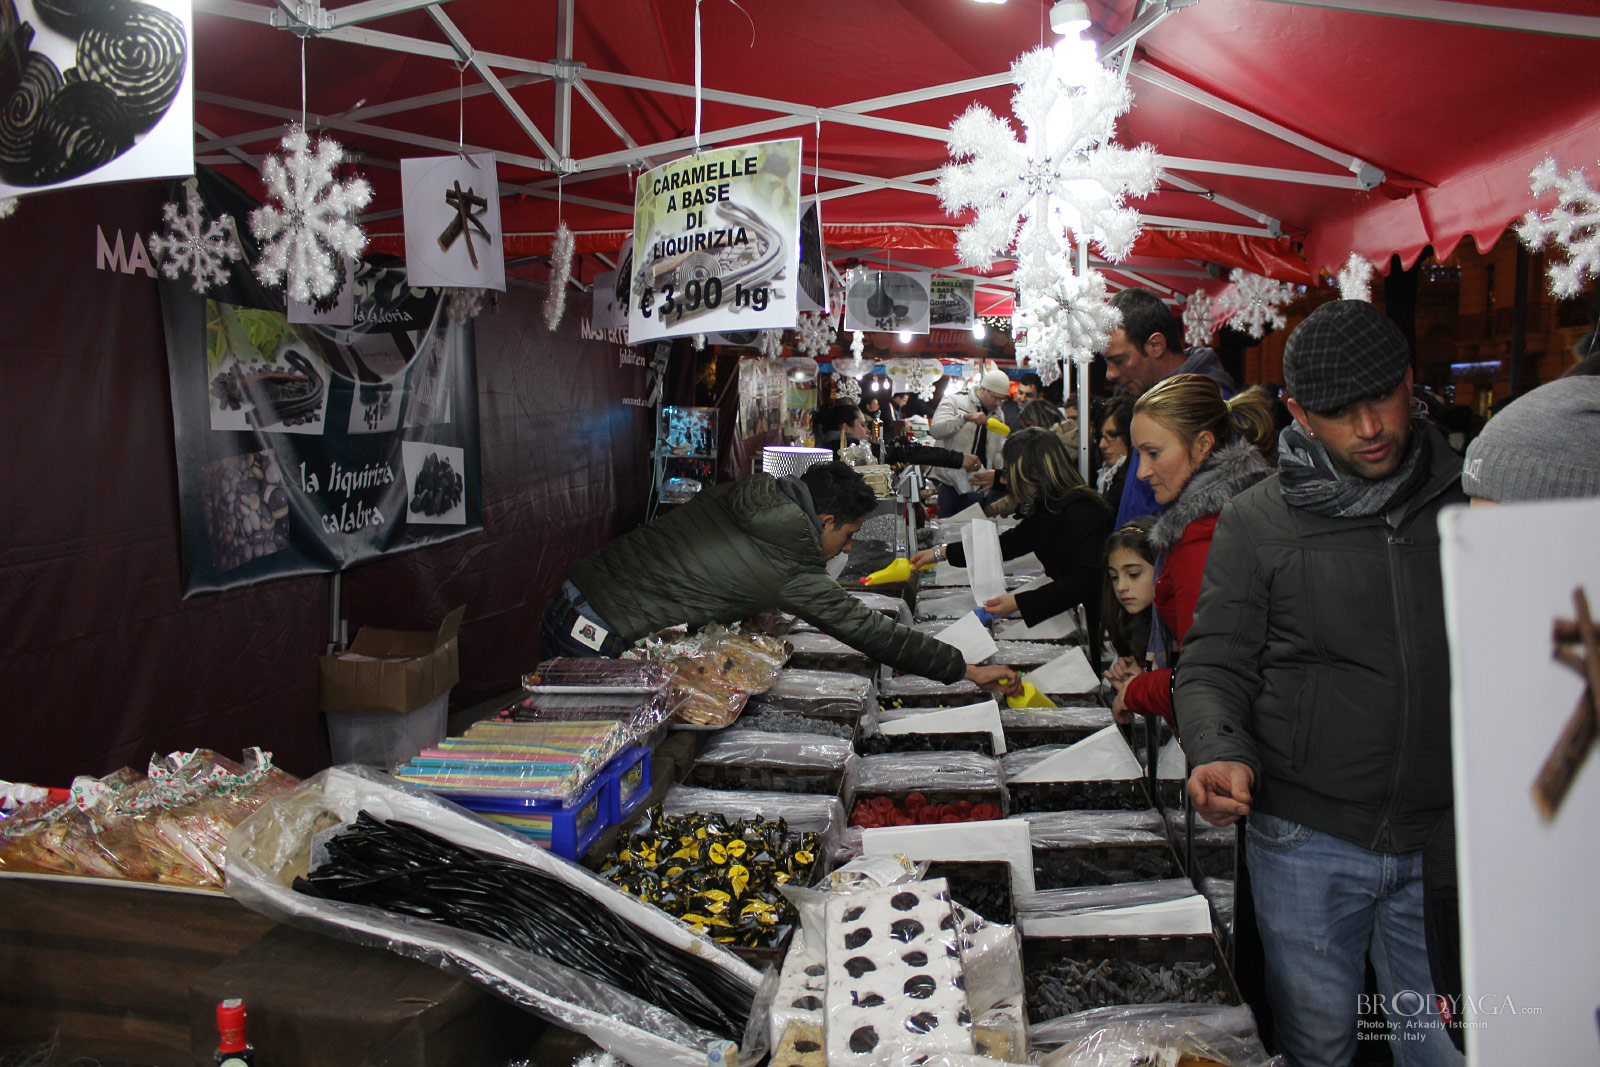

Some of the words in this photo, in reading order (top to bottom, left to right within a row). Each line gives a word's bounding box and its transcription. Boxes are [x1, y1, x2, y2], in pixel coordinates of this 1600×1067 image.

[653, 156, 758, 196] CARAMELLE
[666, 195, 677, 213] A
[682, 184, 730, 209] BASE
[686, 211, 703, 230] DI
[653, 227, 749, 260] LIQUIRIZIA
[659, 276, 723, 321] 3,90
[735, 284, 768, 312] hg
[300, 461, 319, 494] la
[328, 461, 394, 498] liquirizia
[321, 500, 385, 534] calabra
